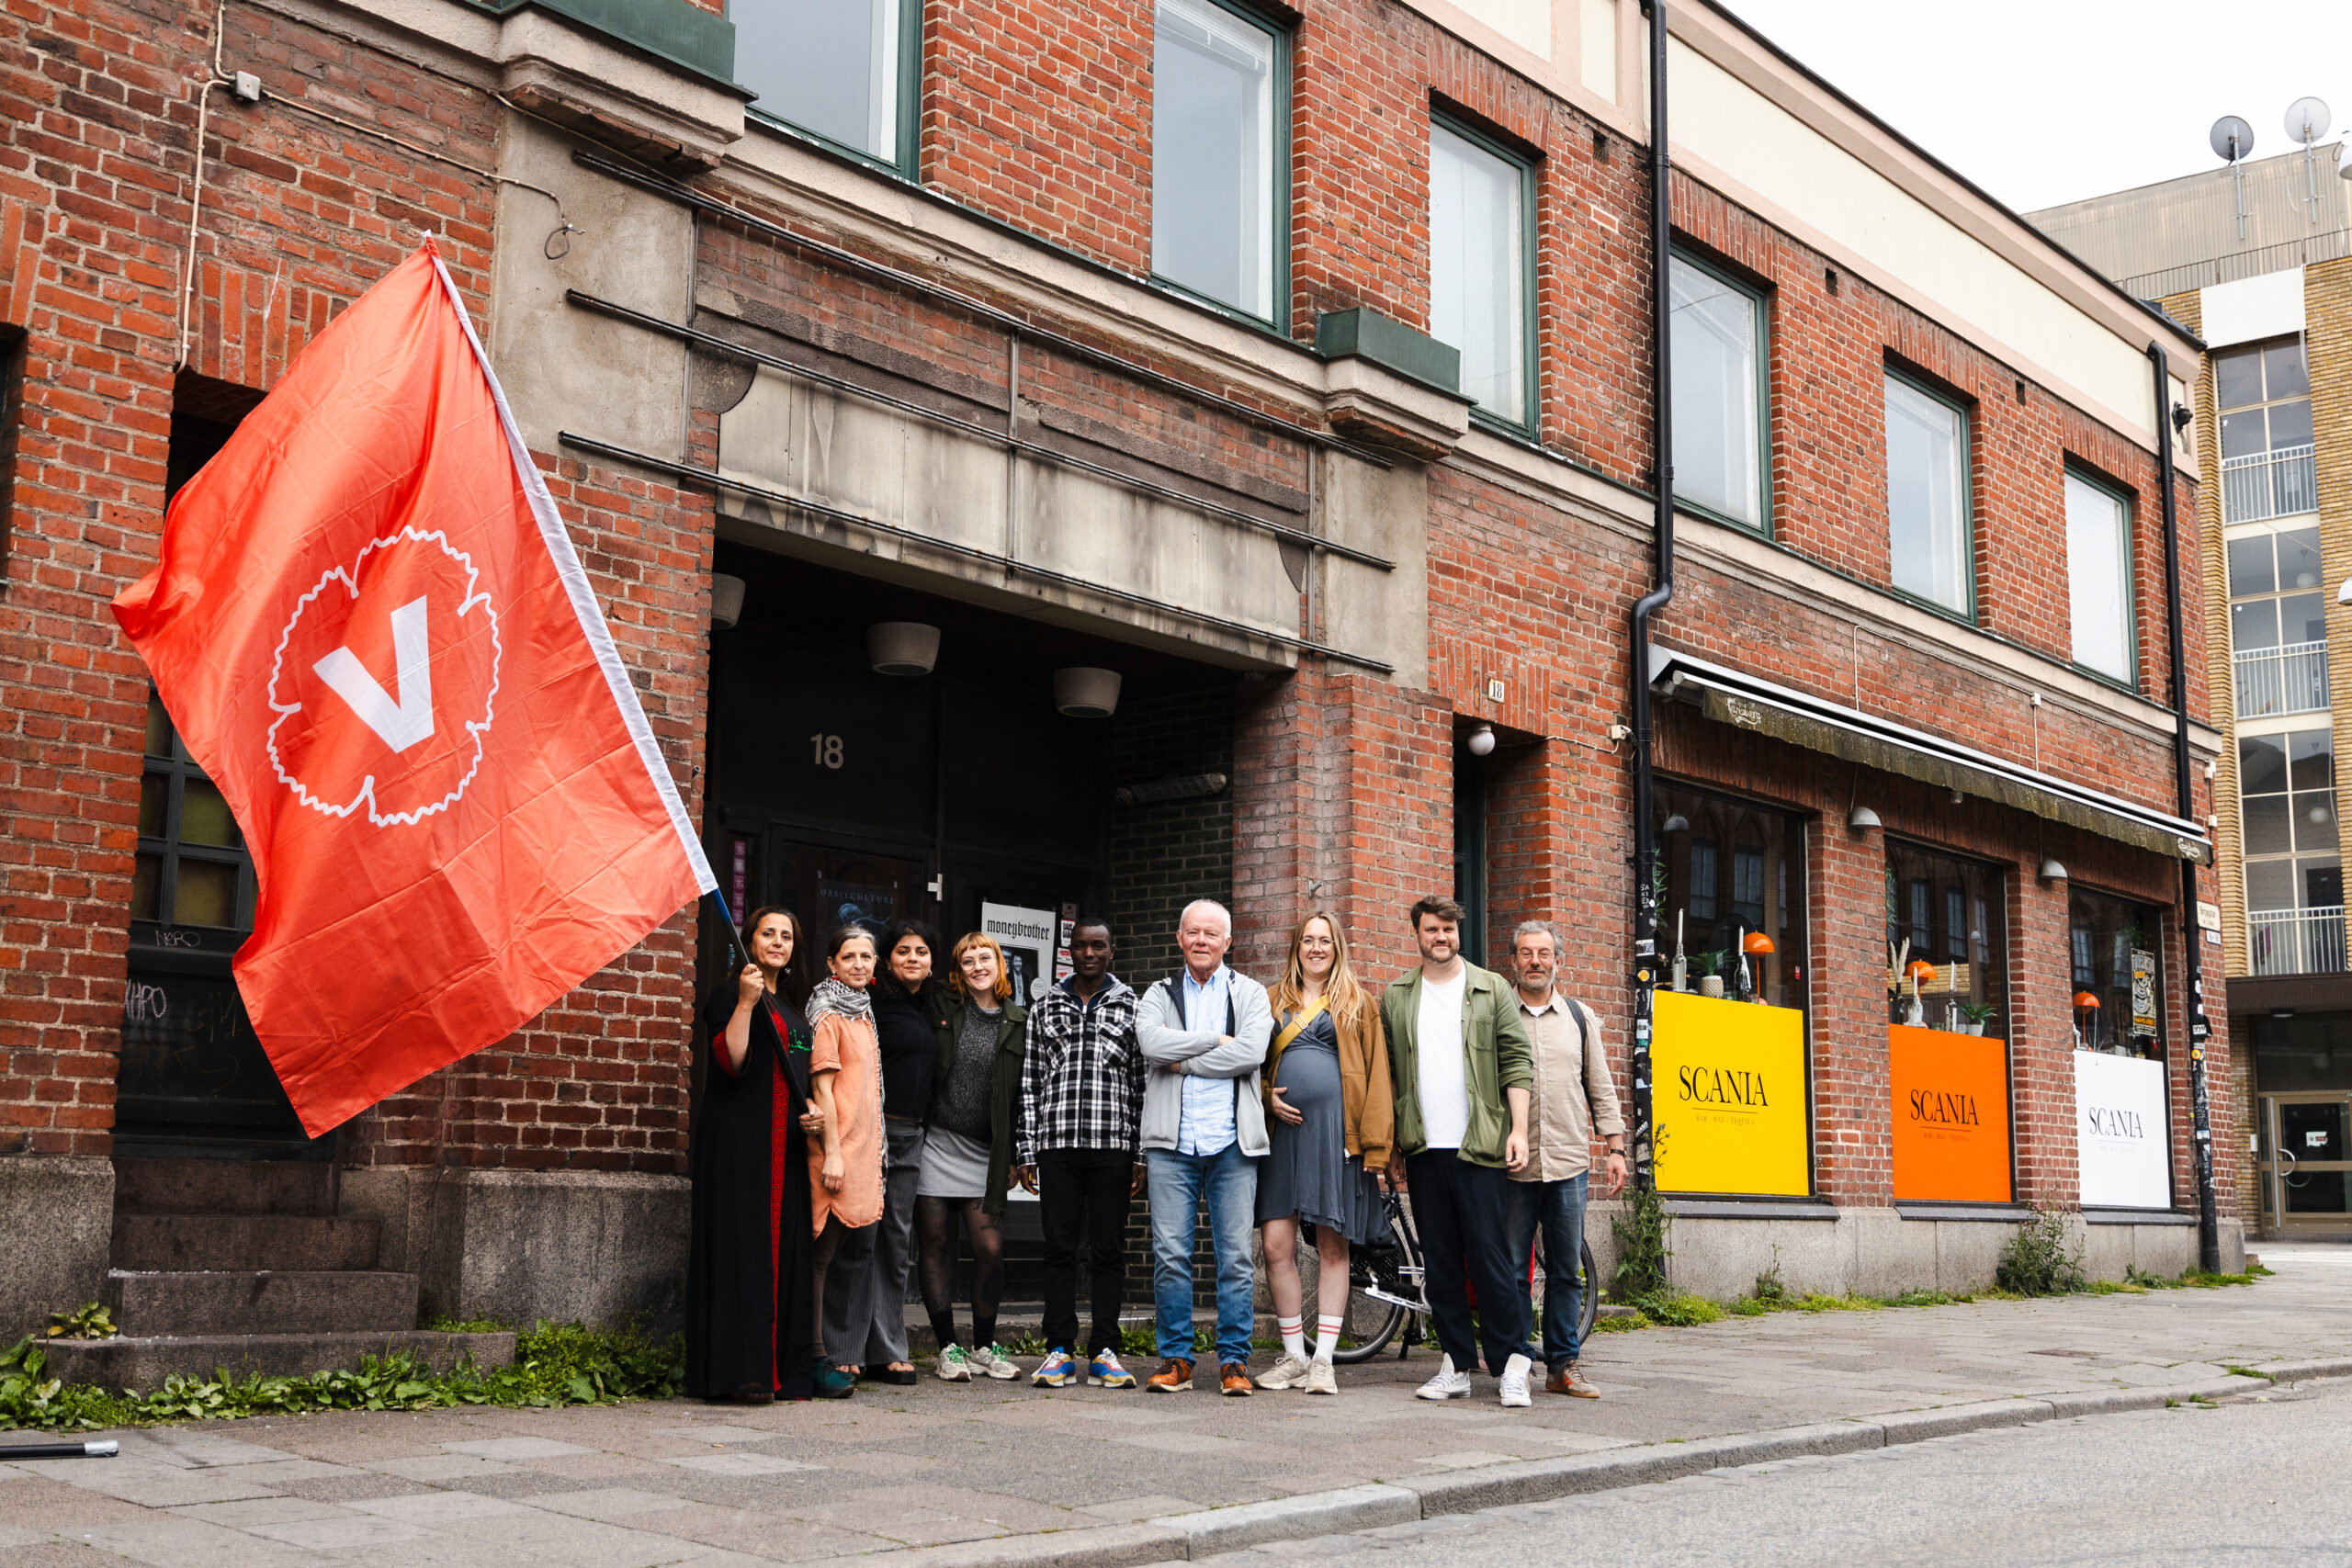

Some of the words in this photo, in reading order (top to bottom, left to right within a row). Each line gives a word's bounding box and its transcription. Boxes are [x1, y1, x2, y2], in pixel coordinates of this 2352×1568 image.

[312, 594, 435, 755] V
[1492, 682, 1503, 699] 18
[810, 733, 844, 770] 18
[987, 919, 1050, 942] moneybrother
[1679, 1065, 1769, 1107] SCANIA
[1910, 1089, 1979, 1126] SCANIA
[2089, 1107, 2143, 1139] SCANIA
